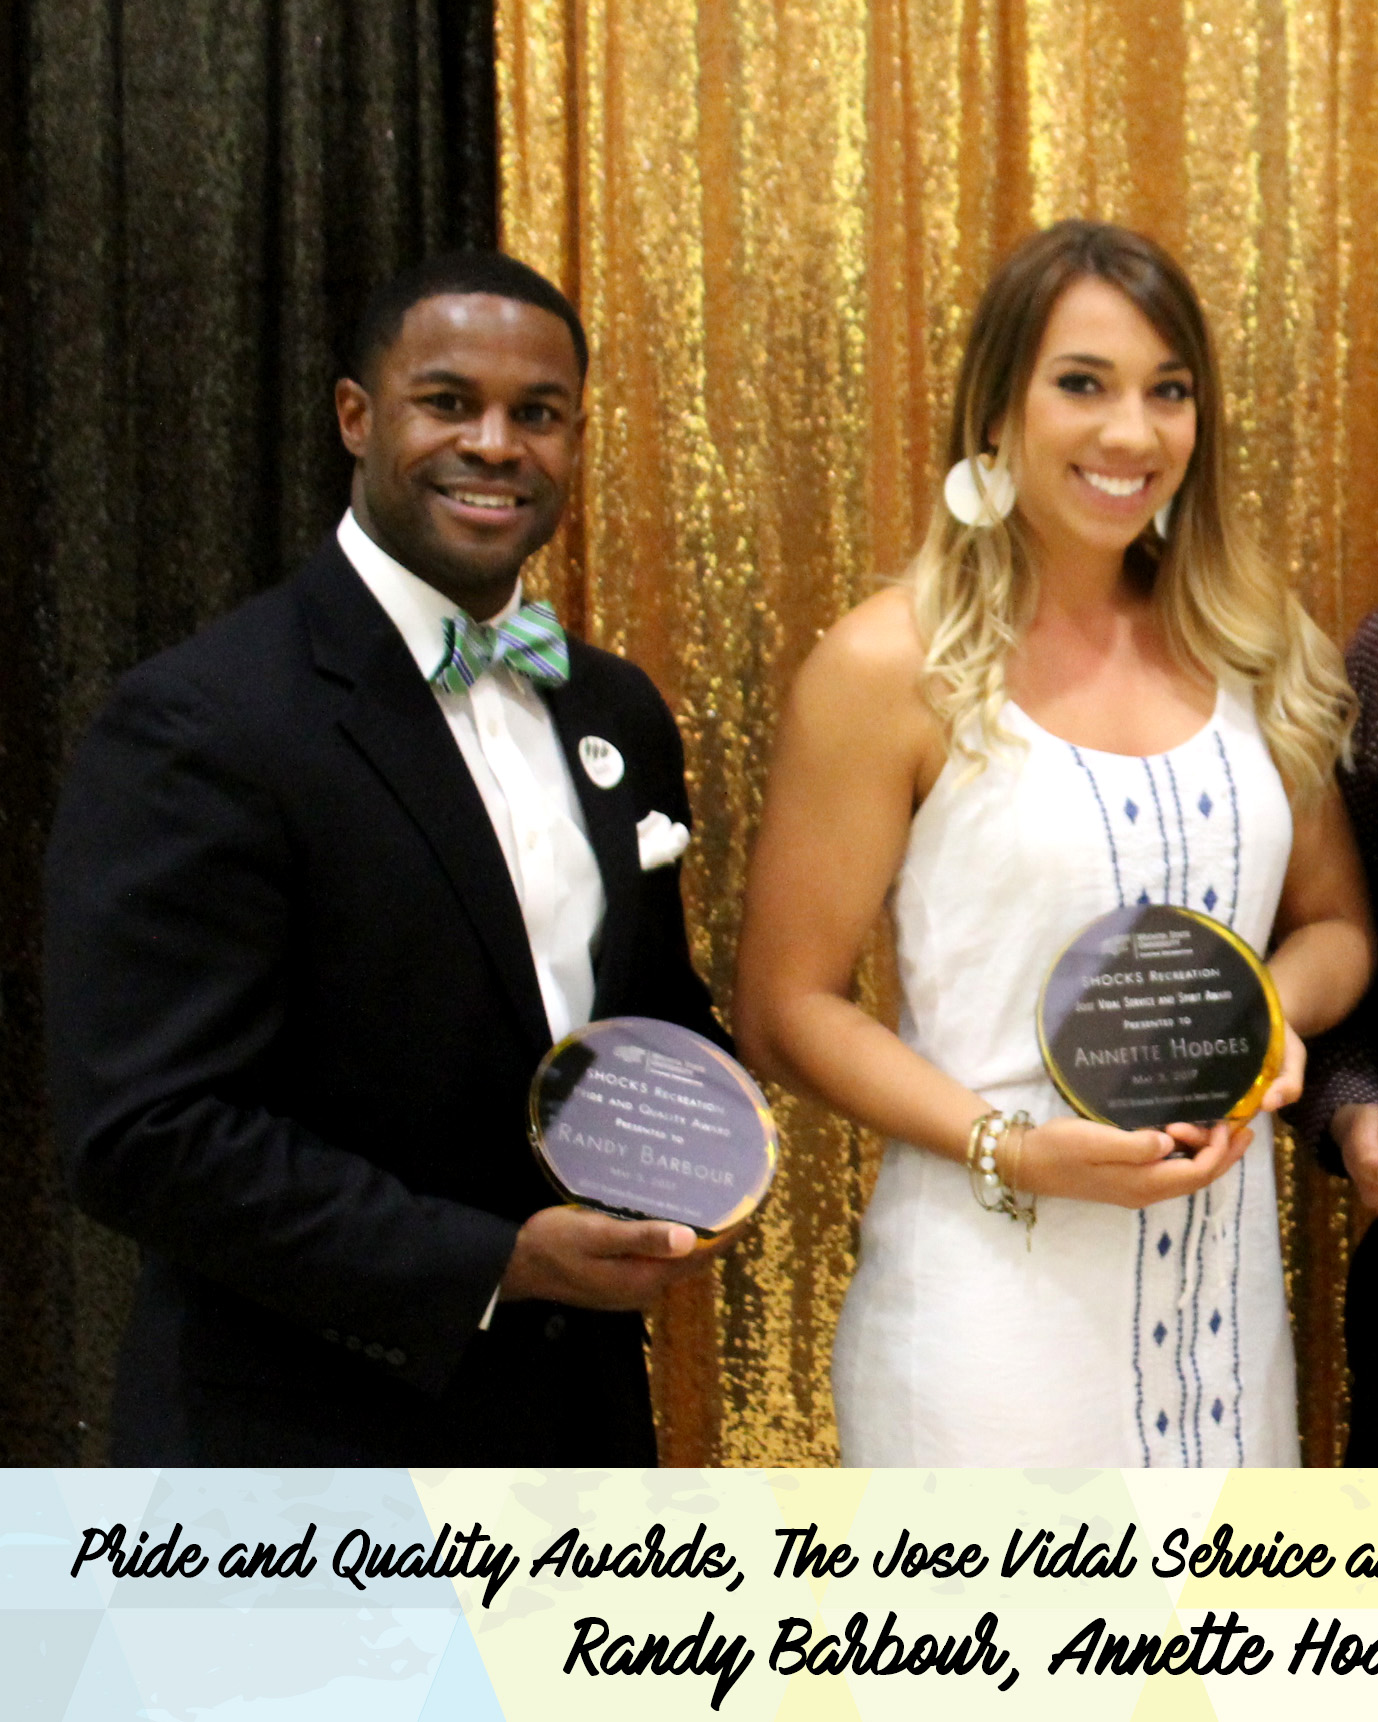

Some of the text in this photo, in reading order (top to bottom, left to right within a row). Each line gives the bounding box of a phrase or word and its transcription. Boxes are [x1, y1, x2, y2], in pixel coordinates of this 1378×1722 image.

[1081, 968, 1221, 988] SHOCKS RECREATION
[1074, 1037, 1249, 1067] ANNETTE HODGES
[586, 1067, 649, 1094] SHOCKS
[558, 1122, 735, 1188] RANDY BARBOUR
